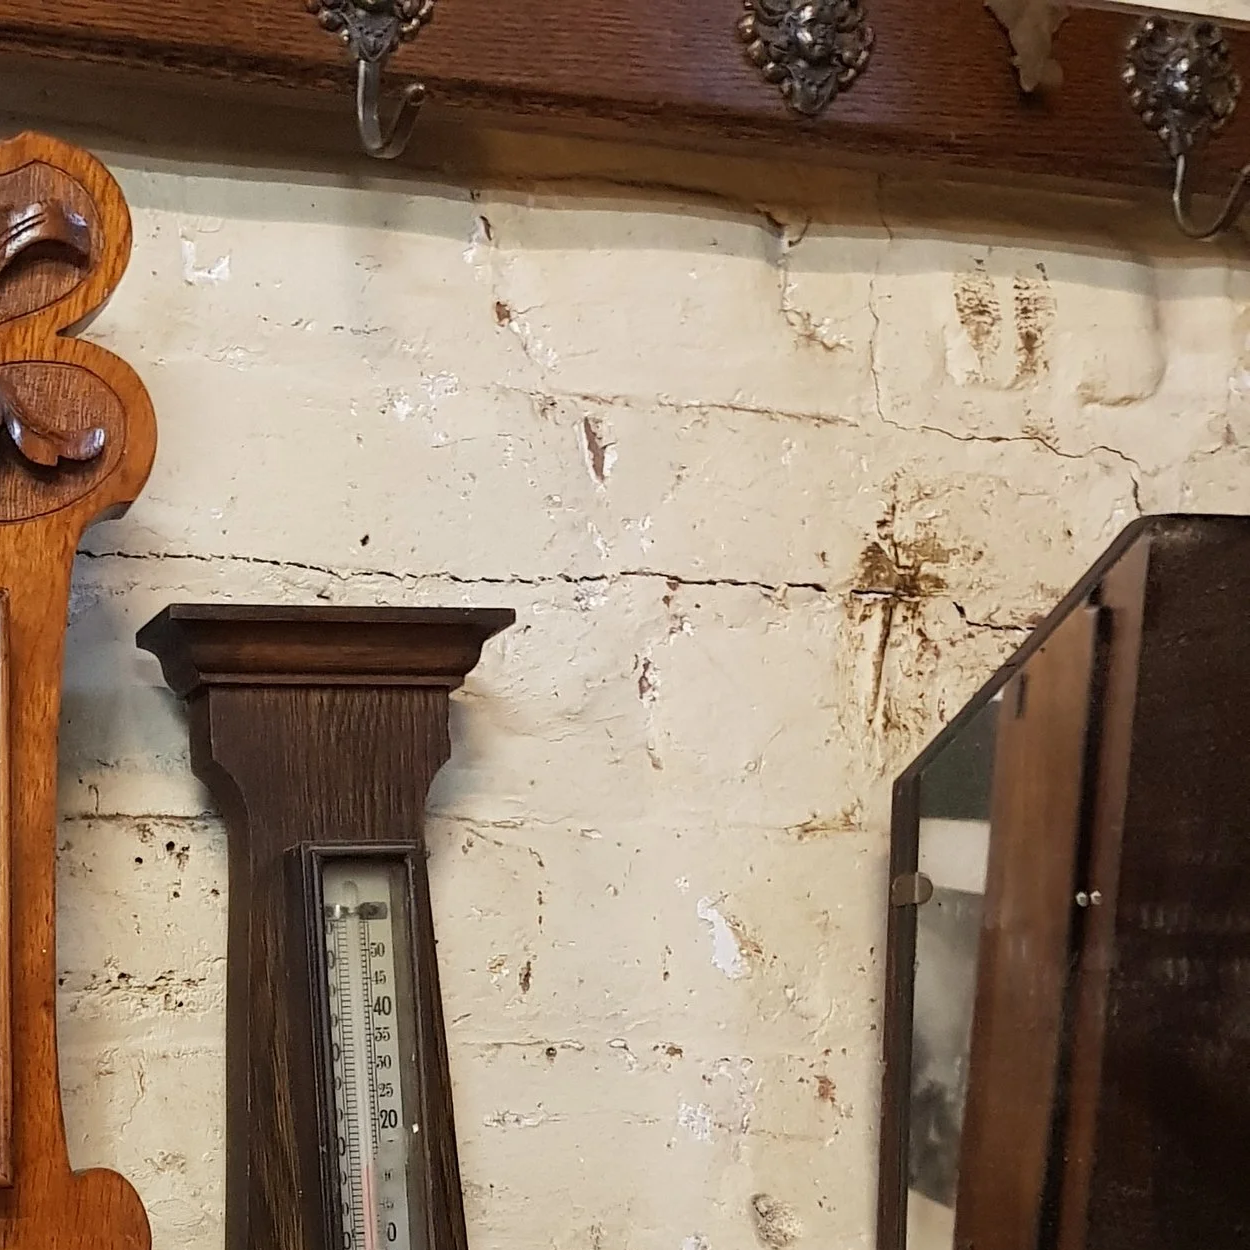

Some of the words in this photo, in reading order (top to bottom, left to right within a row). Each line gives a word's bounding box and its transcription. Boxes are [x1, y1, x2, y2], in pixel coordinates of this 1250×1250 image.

[369, 942, 385, 958] 50
[372, 971, 387, 986] 45
[373, 996, 392, 1016] 40
[378, 1084, 394, 1099] 25
[380, 1109, 398, 1129] 20
[386, 1222, 398, 1243] 0
